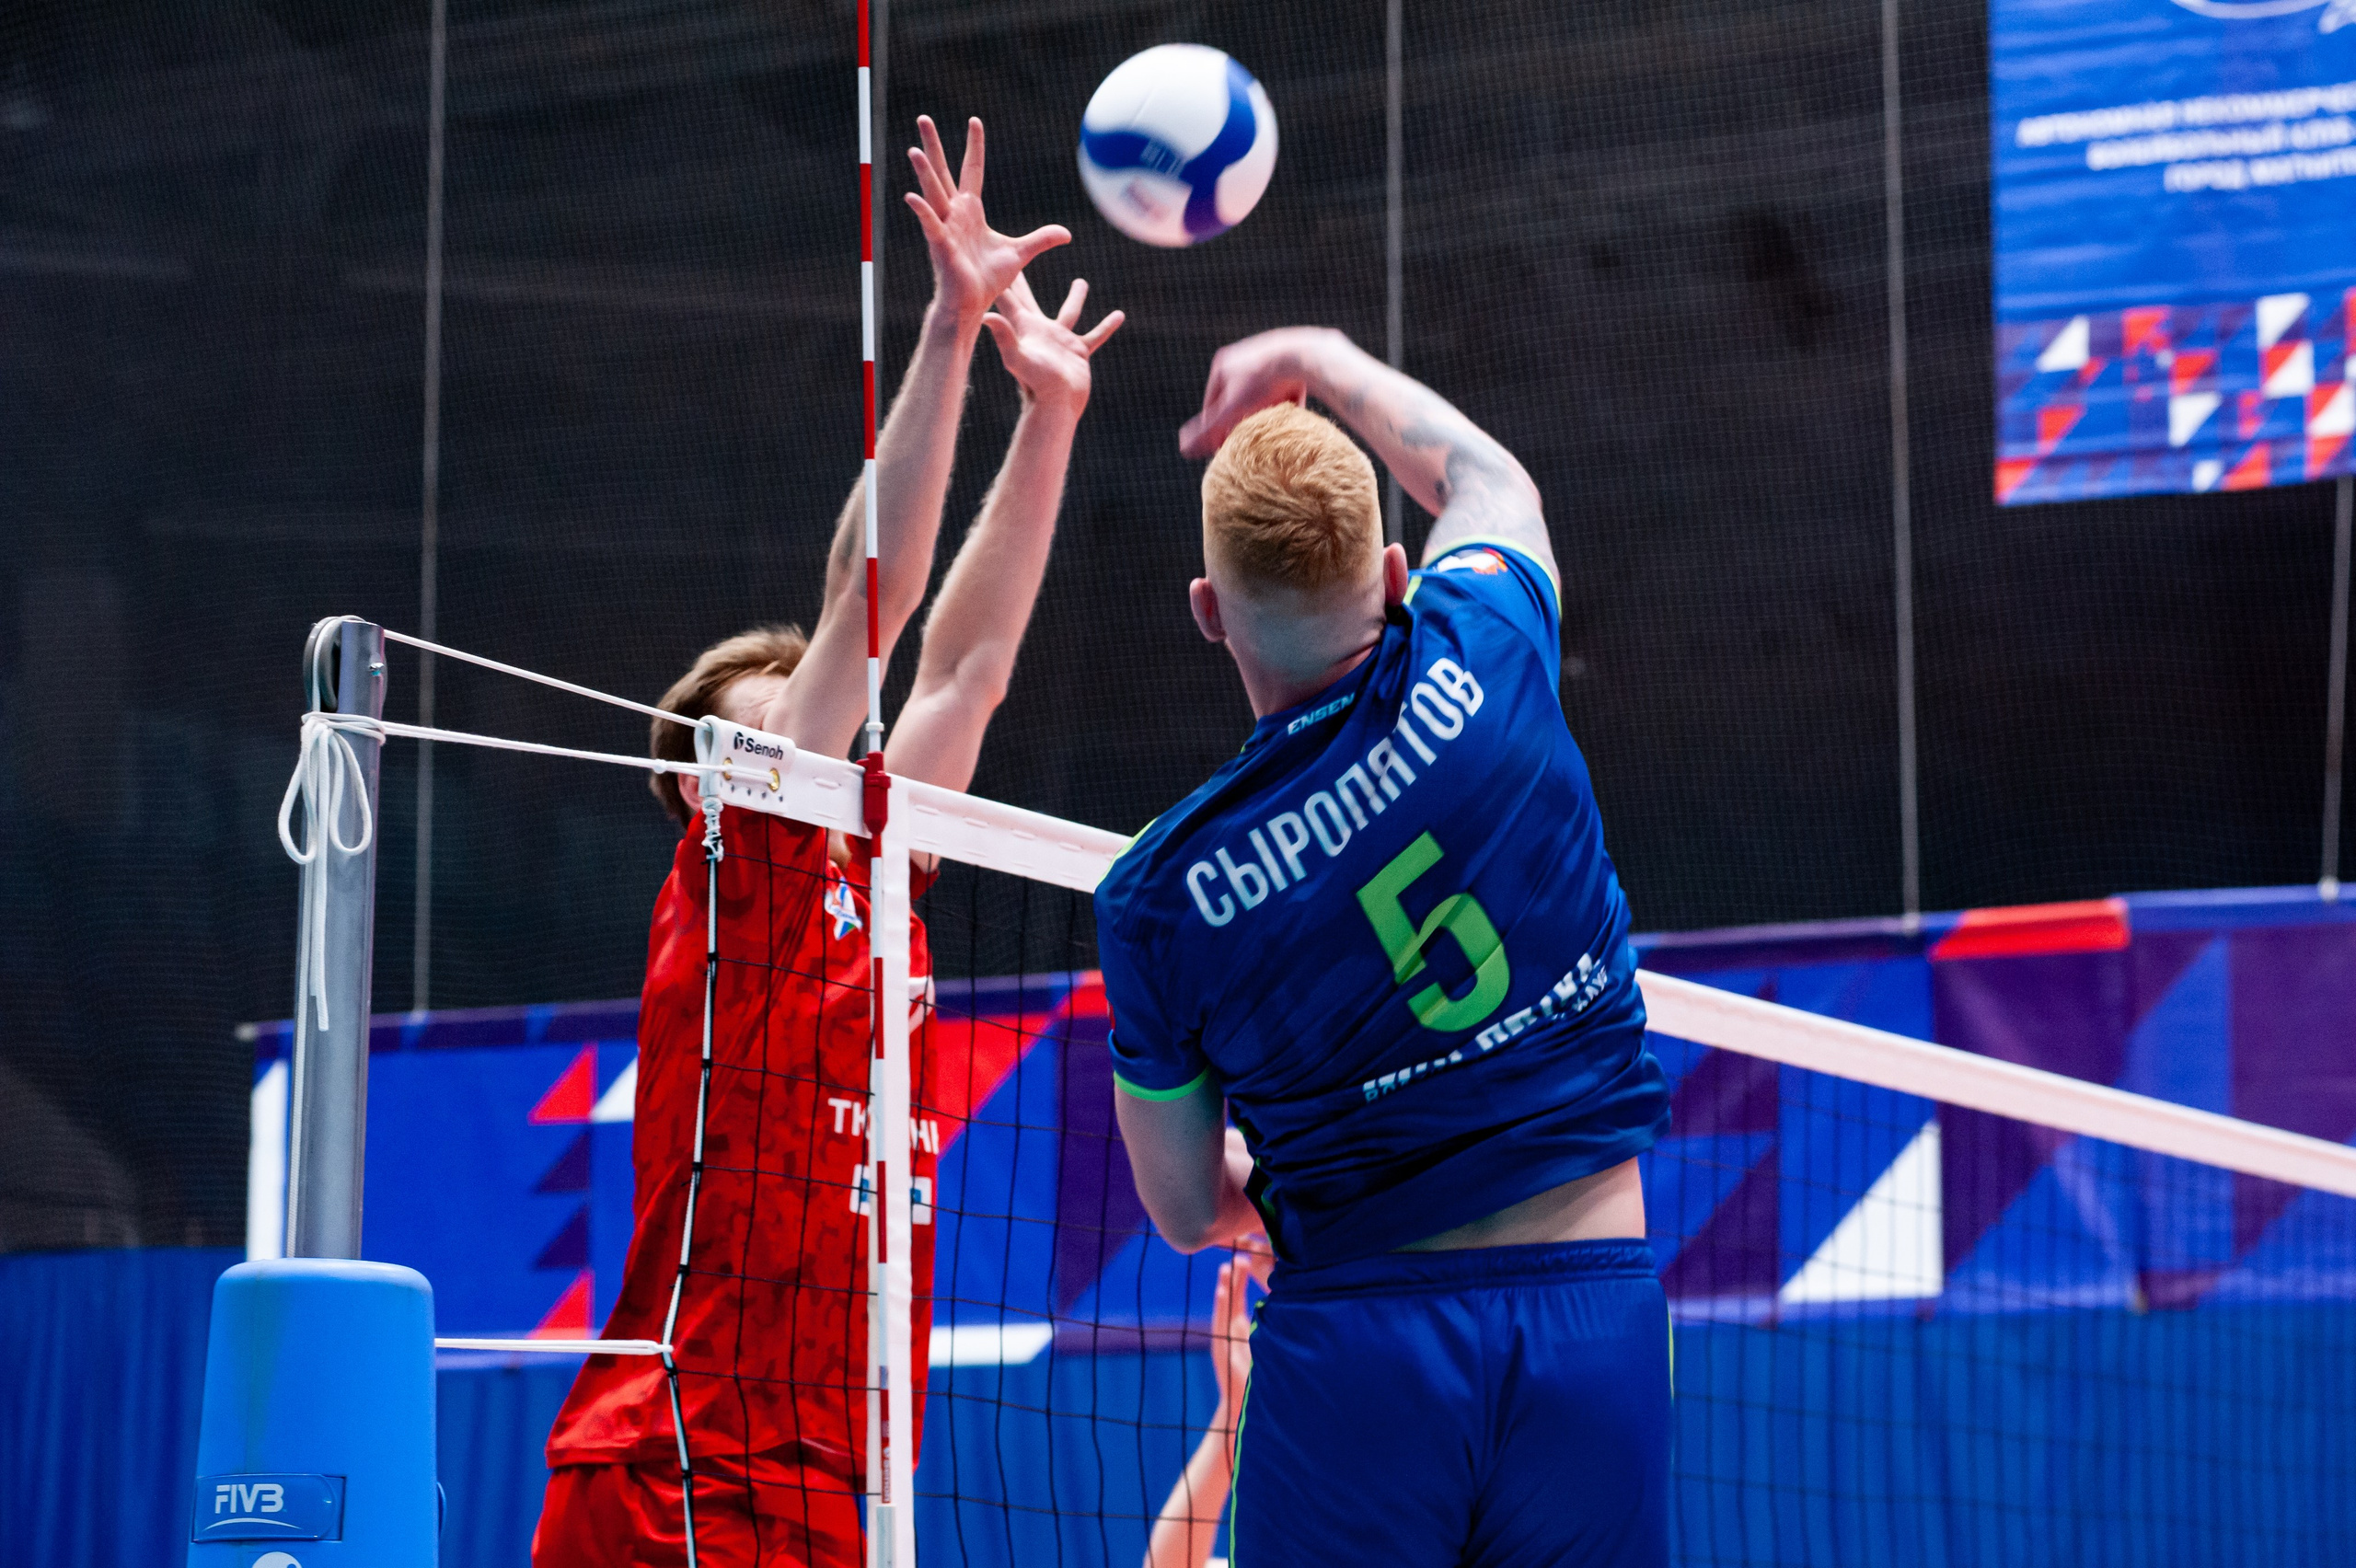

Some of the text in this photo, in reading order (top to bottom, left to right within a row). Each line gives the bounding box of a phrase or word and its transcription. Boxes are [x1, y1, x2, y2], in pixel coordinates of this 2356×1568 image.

[745, 737, 783, 760] Senoh
[1186, 657, 1484, 928] СЫРОПЯТОВ
[1356, 830, 1511, 1033] 5
[214, 1483, 283, 1514] FIVB
